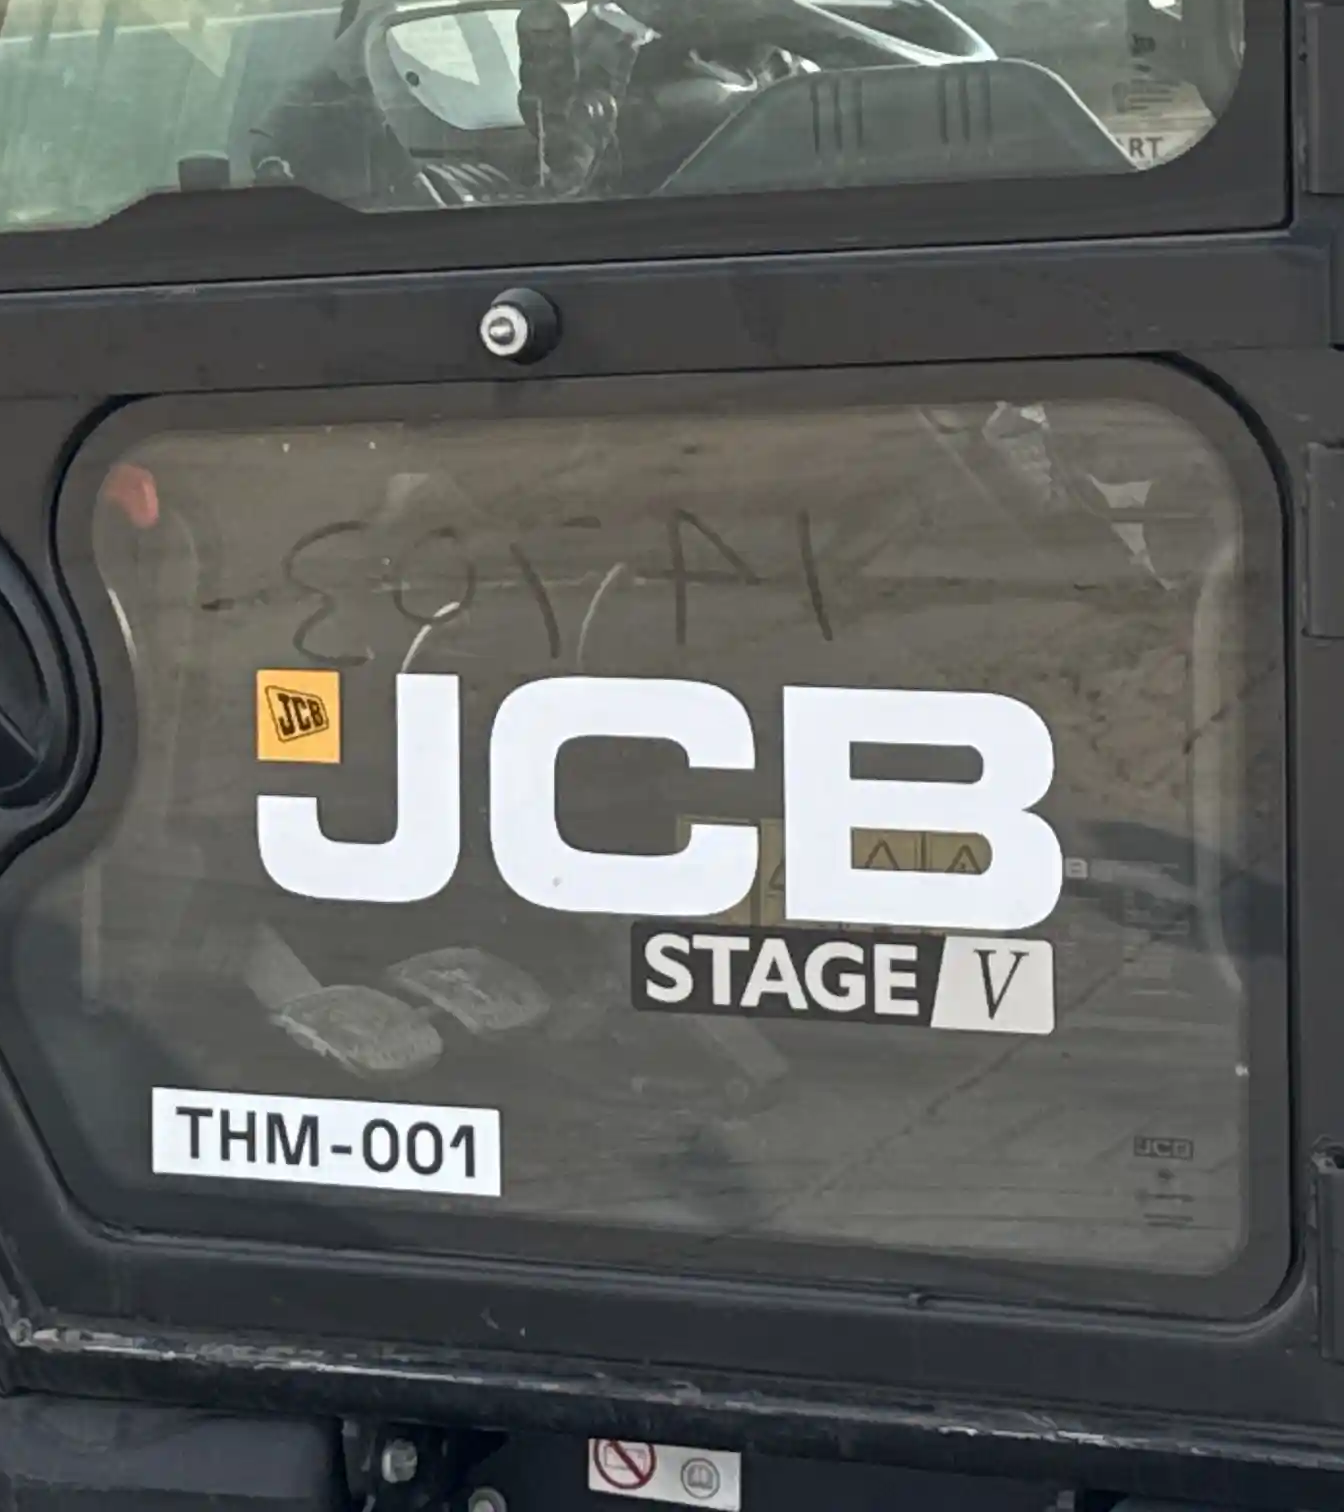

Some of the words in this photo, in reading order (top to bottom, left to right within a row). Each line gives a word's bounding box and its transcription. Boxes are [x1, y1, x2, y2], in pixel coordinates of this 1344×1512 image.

[1116, 137, 1163, 159] RT
[276, 692, 325, 737] JCB
[256, 672, 1064, 932] JCB
[643, 932, 921, 1017] STAGE
[972, 948, 1031, 1021] V
[175, 1105, 477, 1179] THM-001
